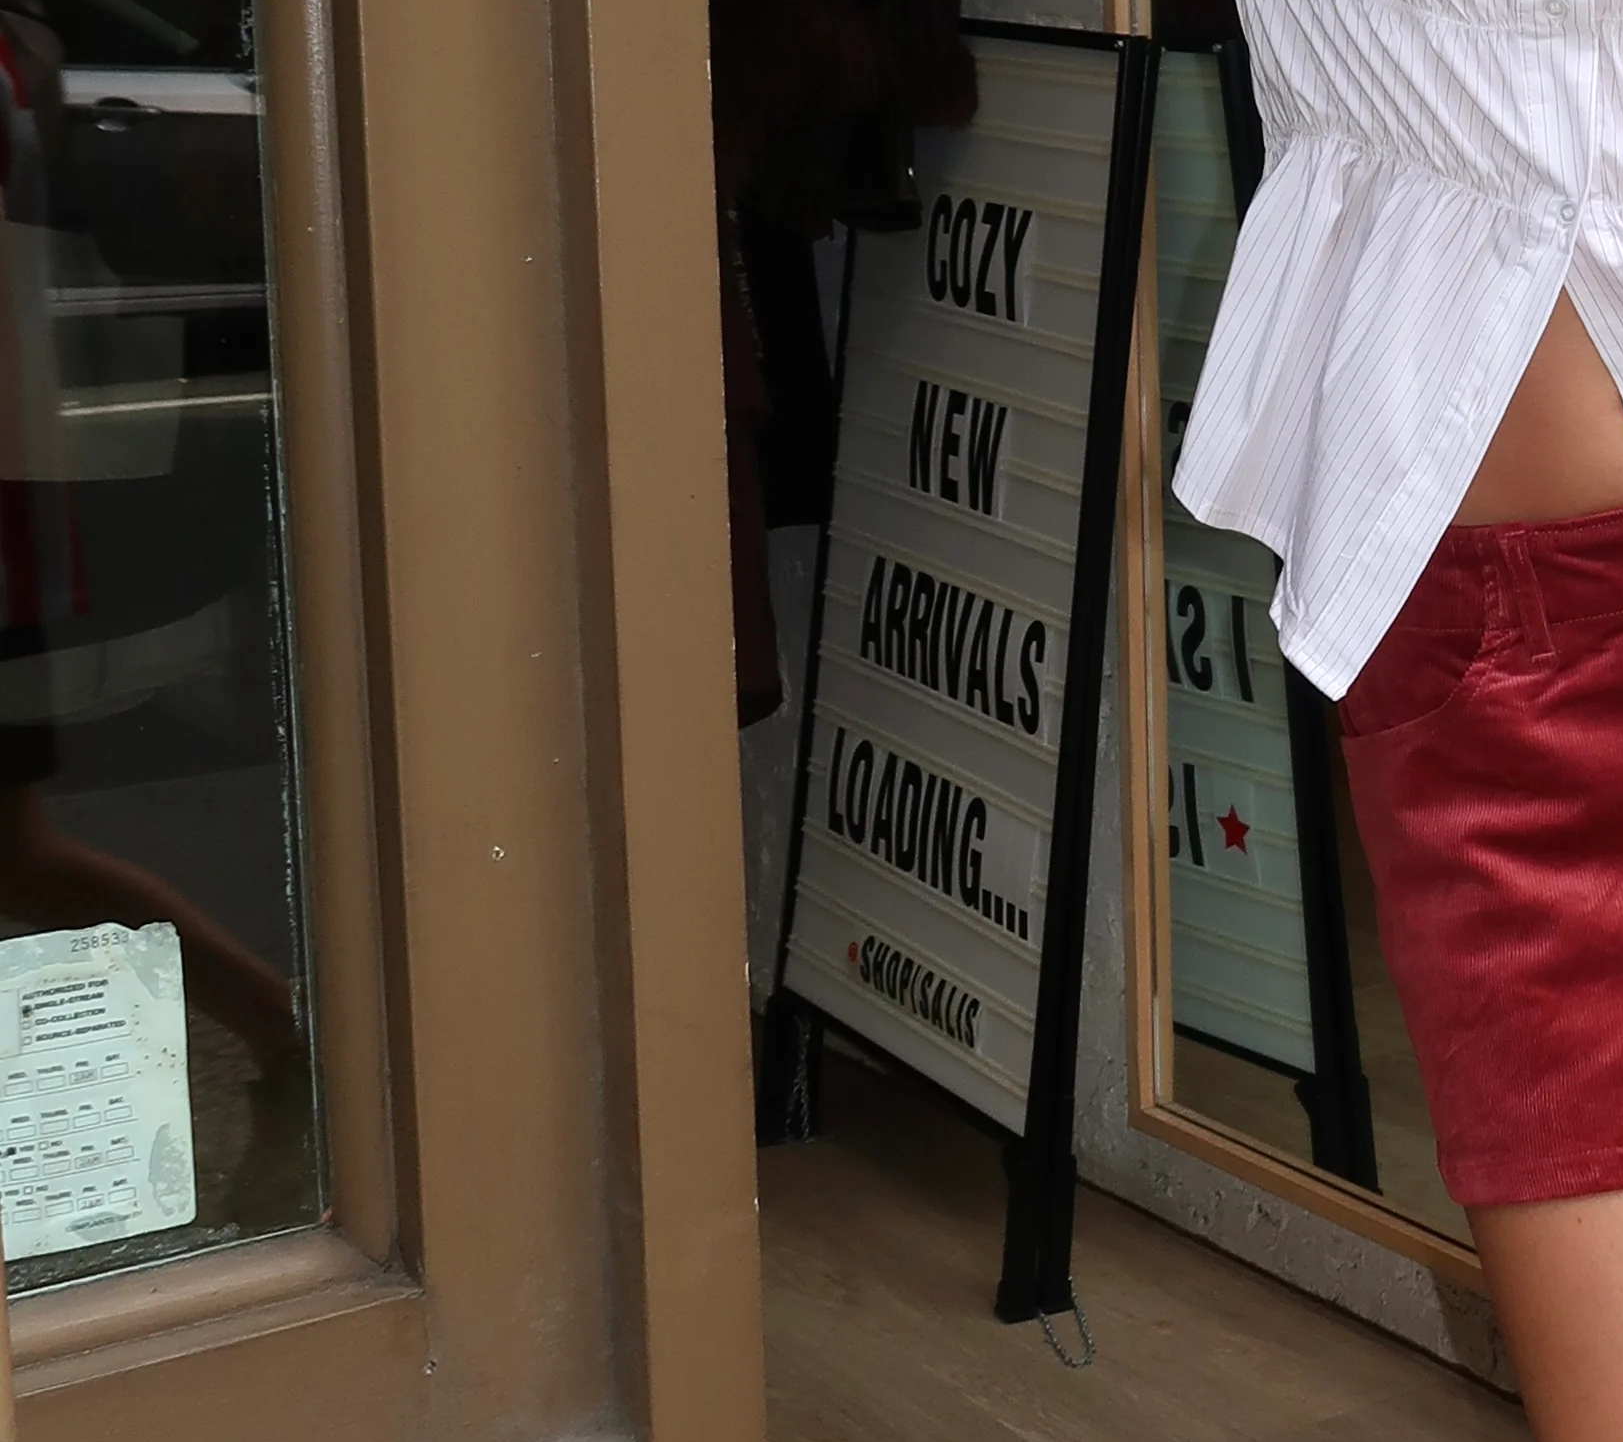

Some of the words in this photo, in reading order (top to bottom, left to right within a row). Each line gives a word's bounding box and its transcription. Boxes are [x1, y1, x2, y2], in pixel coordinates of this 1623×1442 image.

[926, 193, 1033, 322] COZY
[909, 379, 1007, 516] NEW
[860, 555, 1046, 735] ARRIVALS
